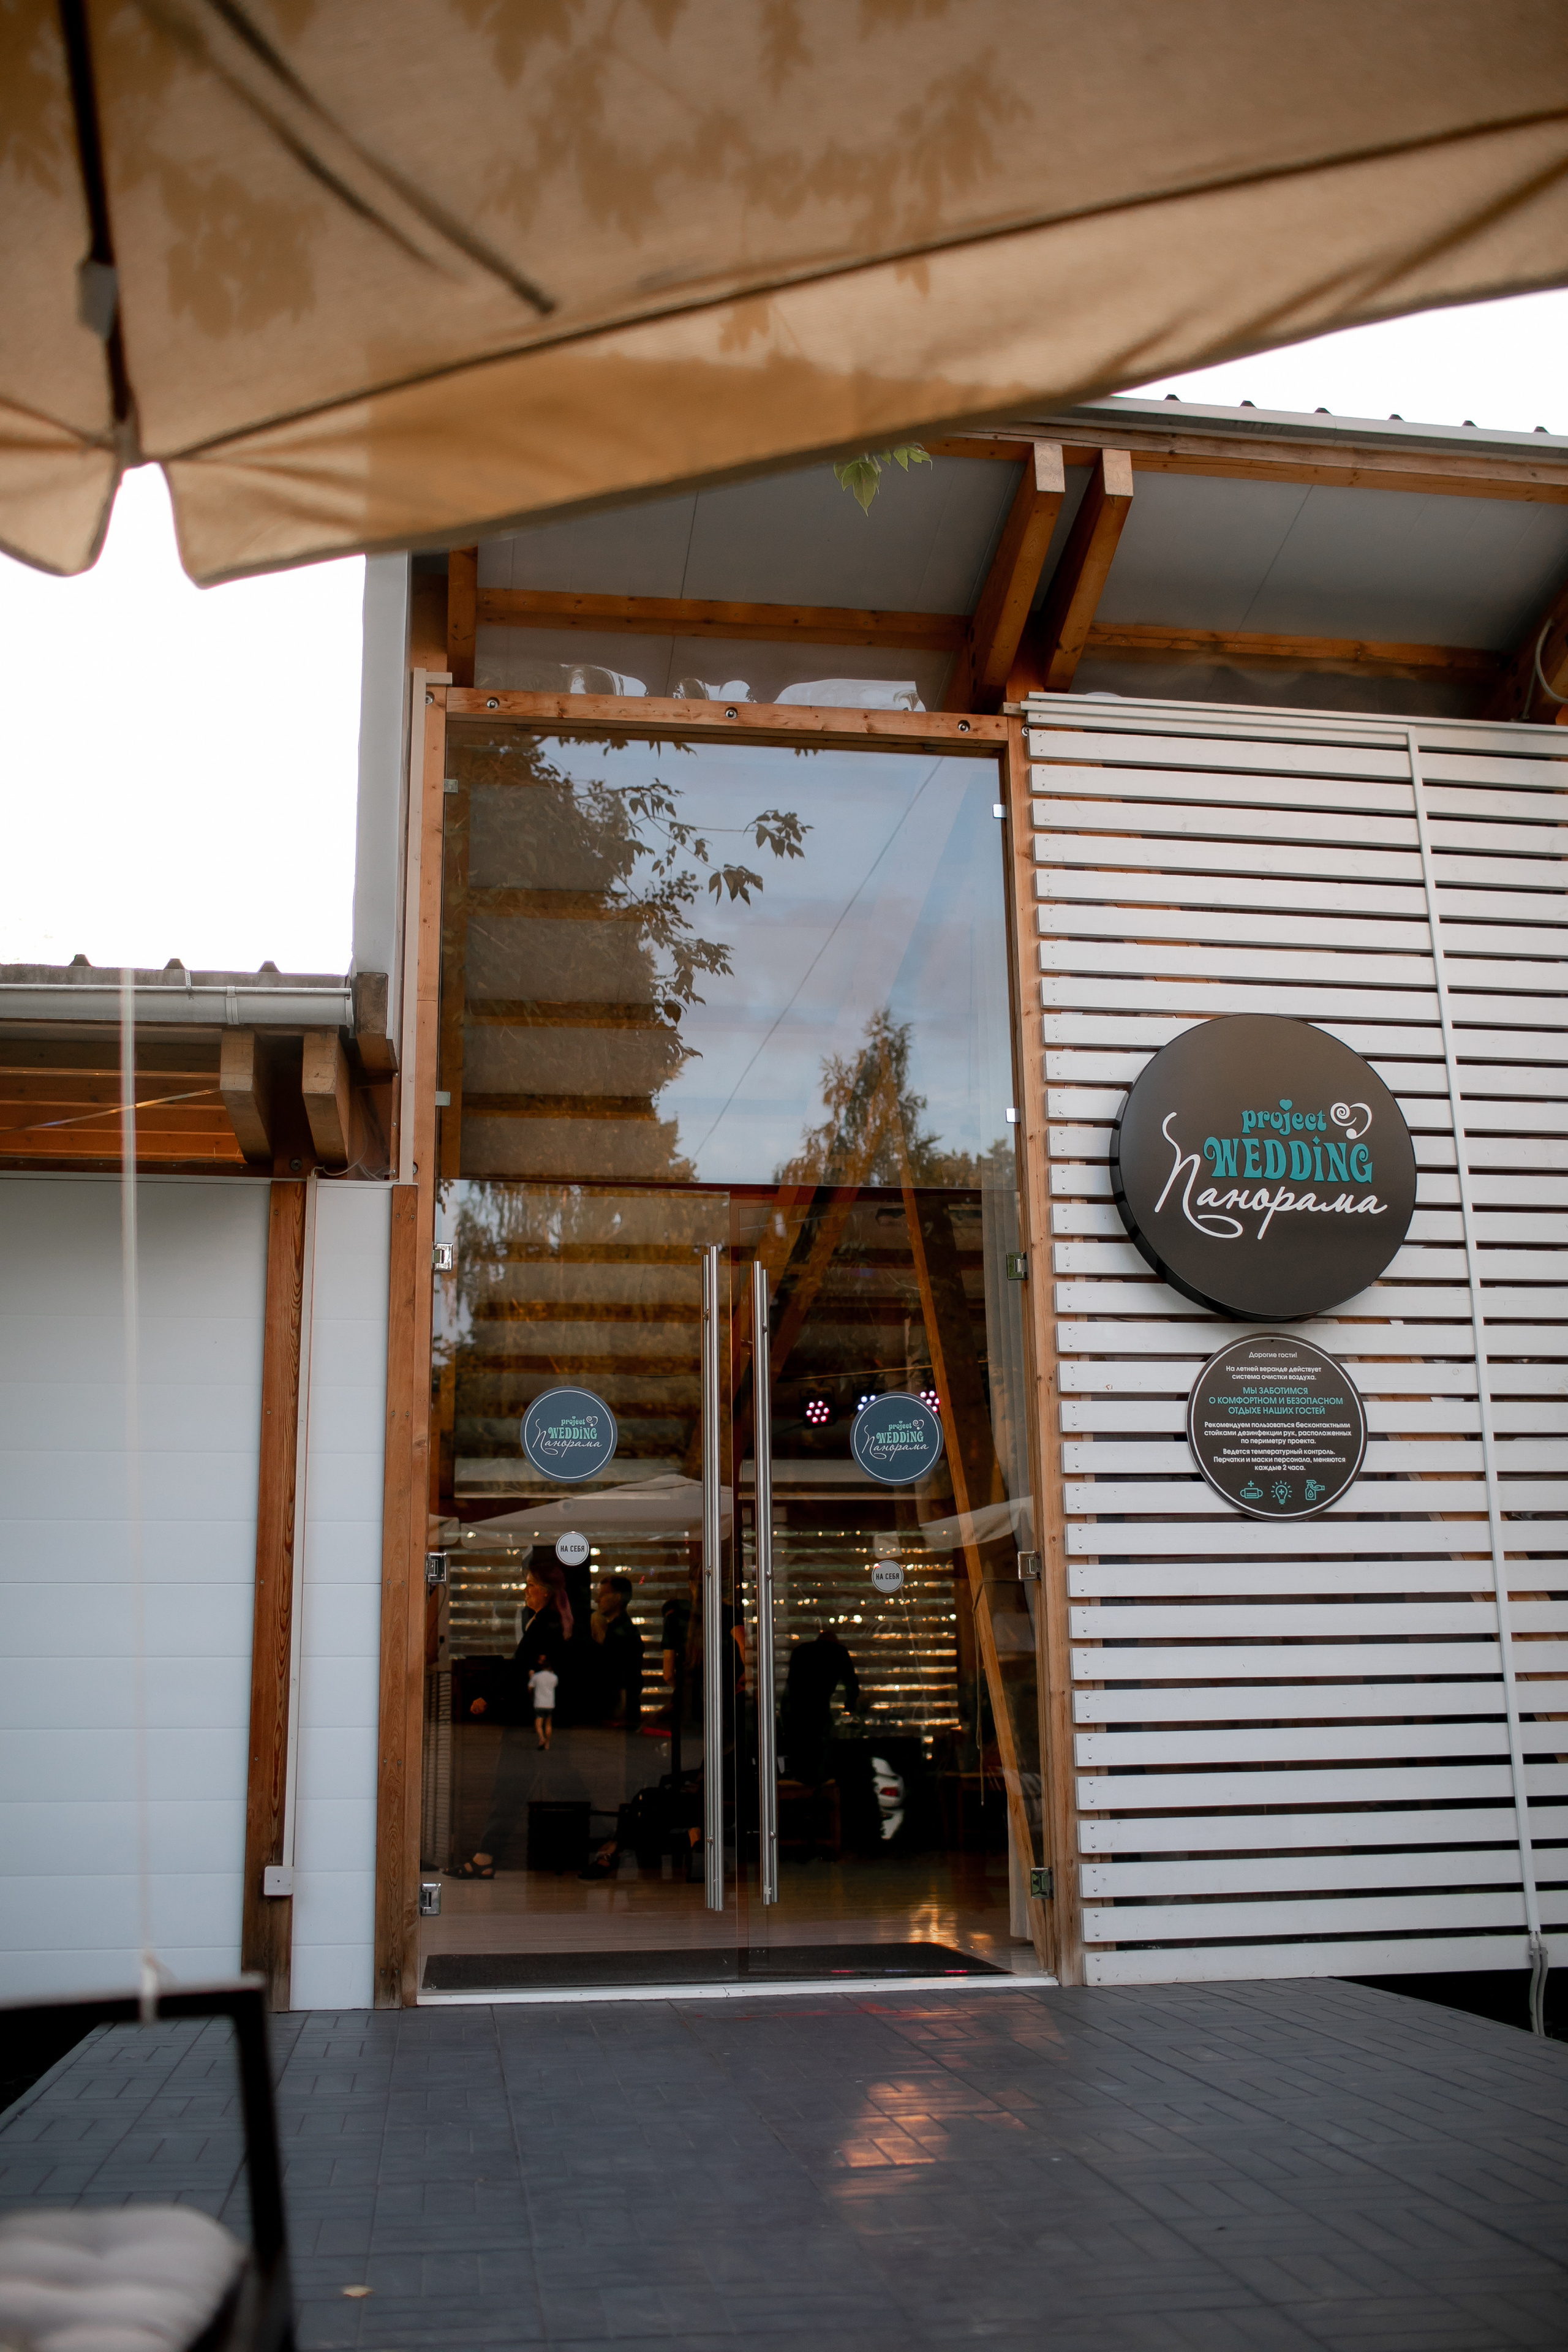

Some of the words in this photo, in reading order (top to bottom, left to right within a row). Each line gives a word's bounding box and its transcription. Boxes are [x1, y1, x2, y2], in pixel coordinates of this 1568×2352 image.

[1242, 1099, 1327, 1136] project
[1155, 1112, 1387, 1240] Панорама
[561, 1416, 586, 1426] project
[889, 1420, 912, 1431] project
[1295, 1406, 1325, 1414] ГОСТЕЙ
[532, 1419, 603, 1458] Панорама
[861, 1425, 929, 1461] Панорама
